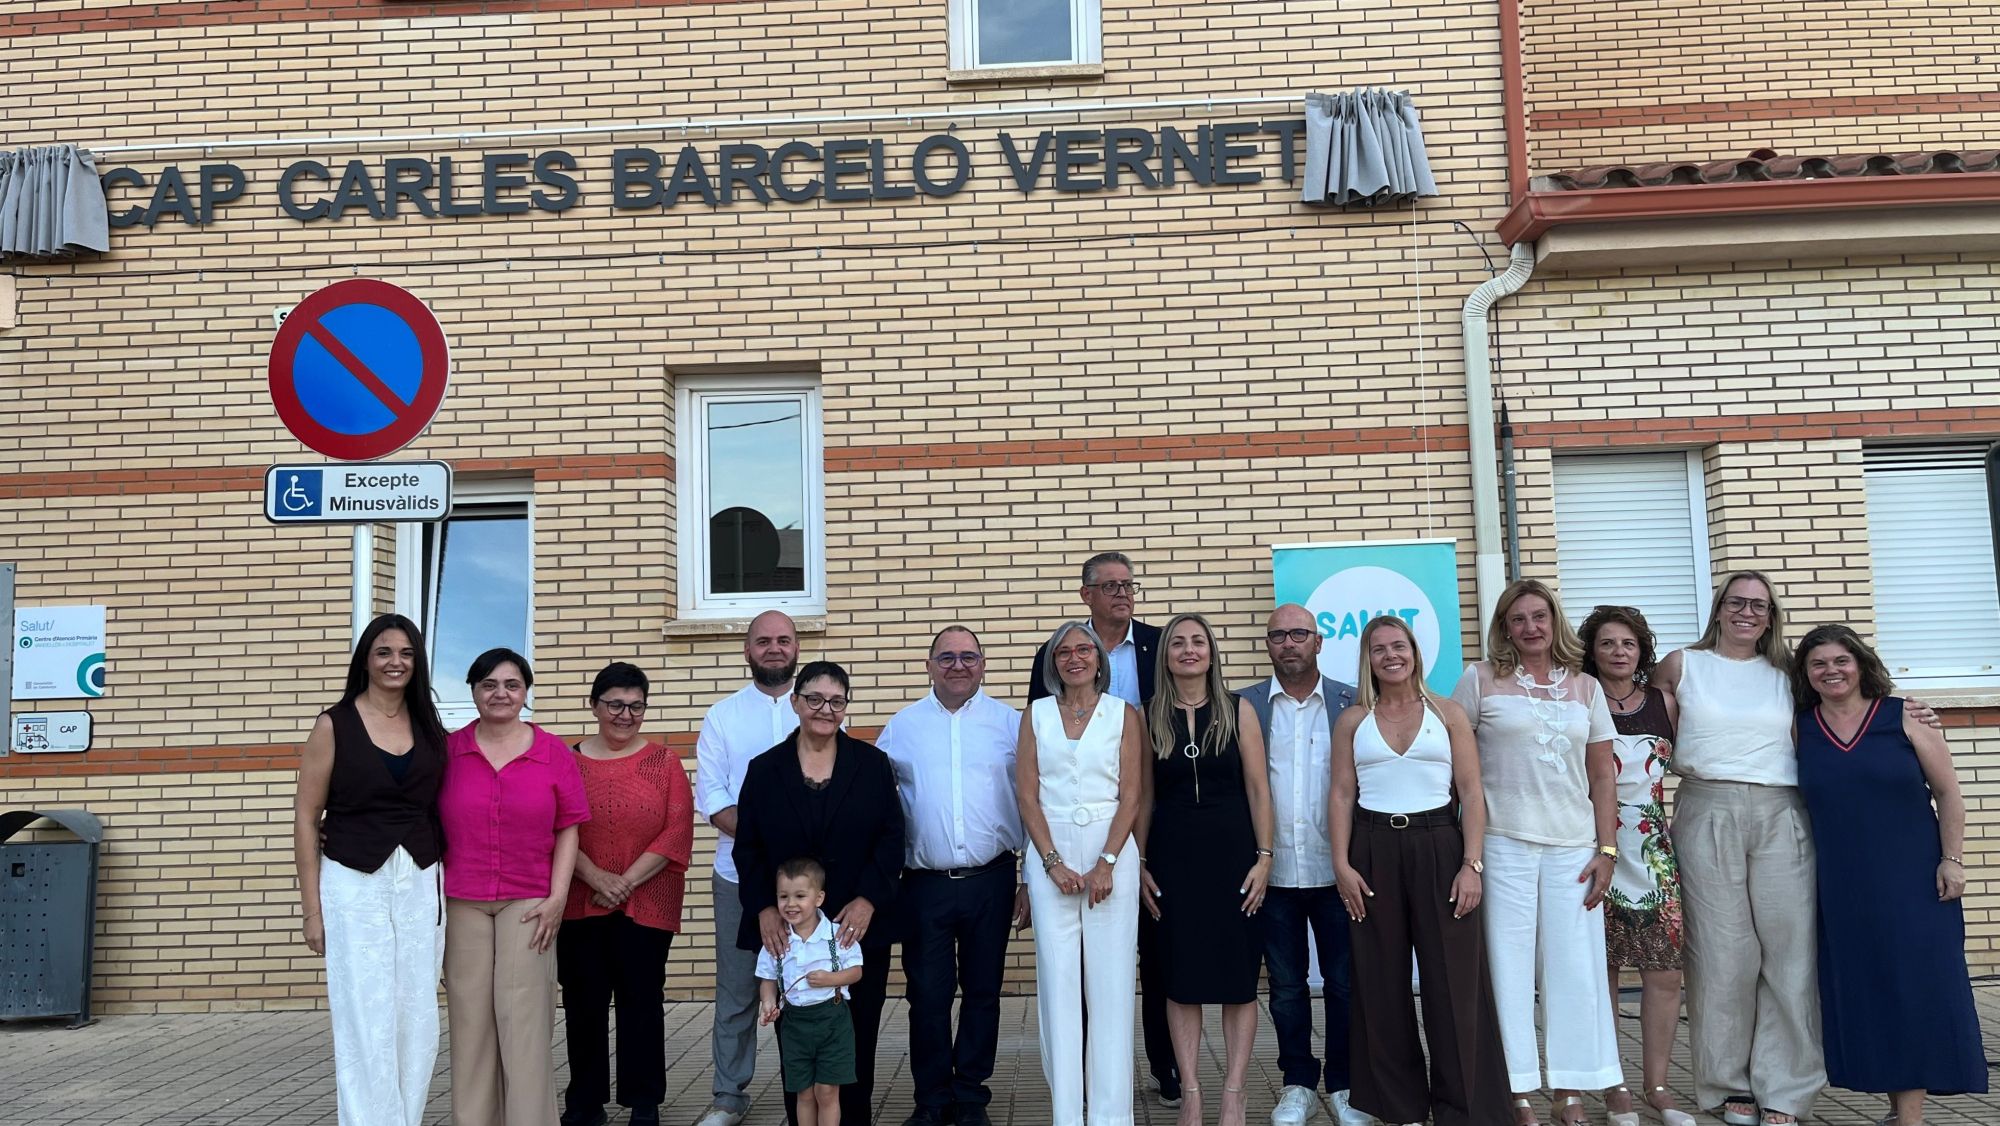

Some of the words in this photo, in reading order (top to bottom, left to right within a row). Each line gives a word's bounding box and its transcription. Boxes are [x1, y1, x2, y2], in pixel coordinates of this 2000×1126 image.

[101, 163, 246, 228] CAP
[278, 149, 579, 222] CARLES
[613, 121, 971, 208] BARCELÓ
[999, 119, 1306, 193] VERNET
[344, 472, 420, 490] Excepte
[329, 494, 439, 512] Minusvàlids
[1316, 607, 1420, 641] SAT
[60, 725, 78, 734] CAP
